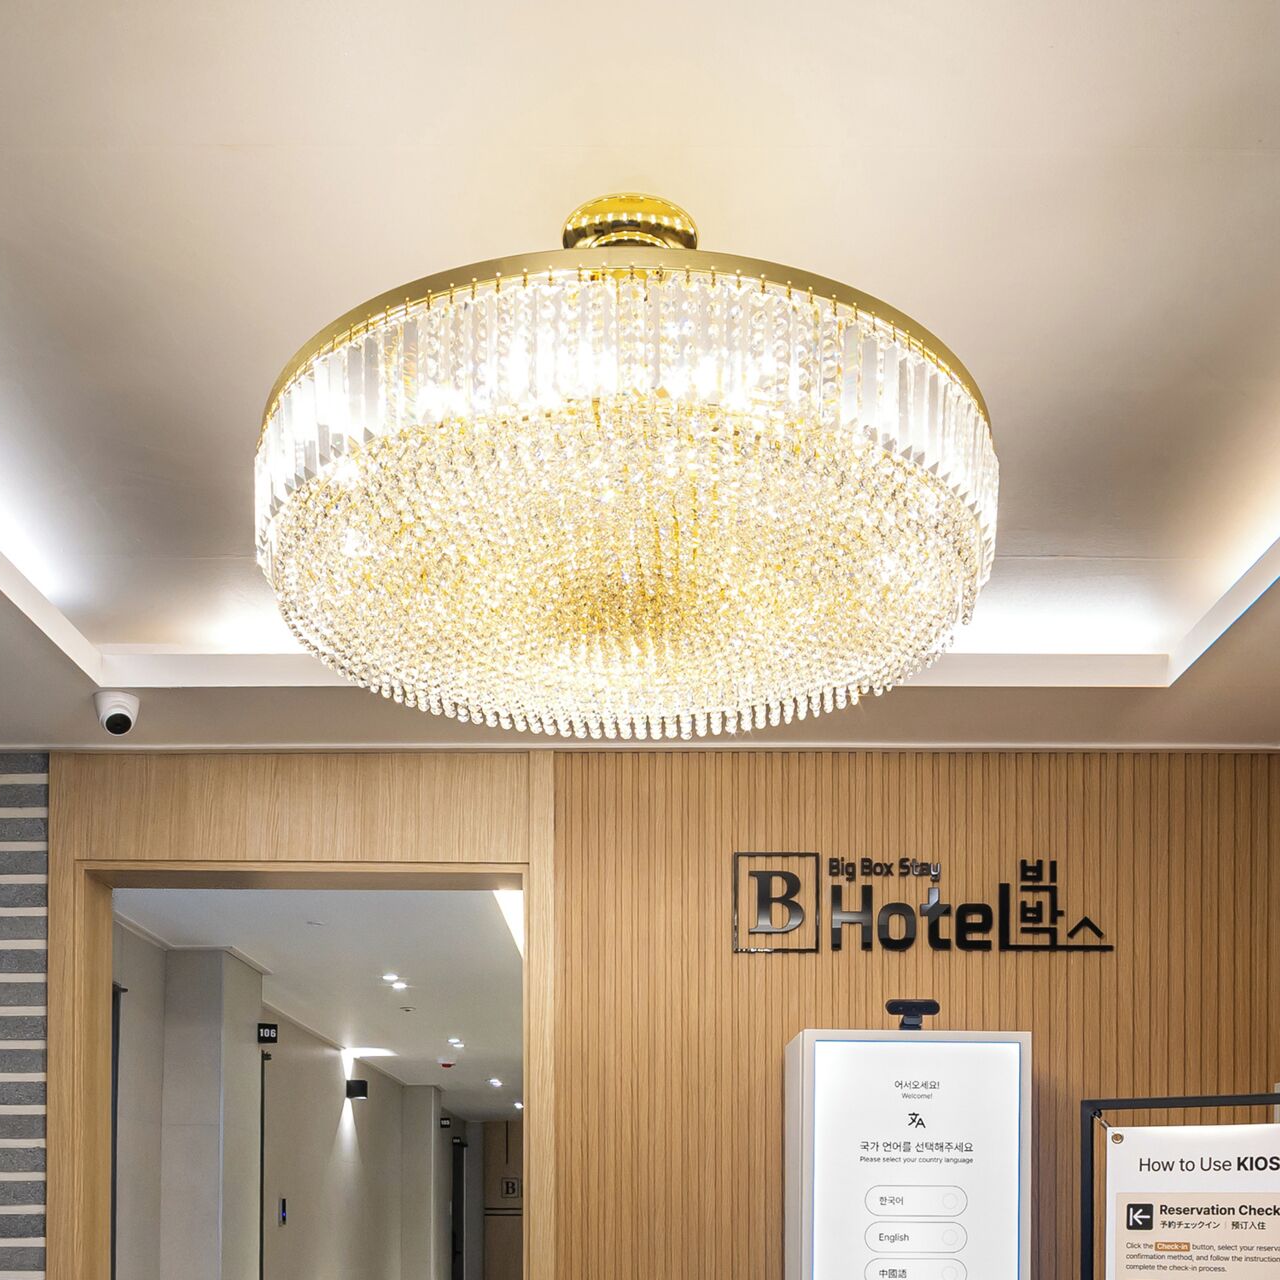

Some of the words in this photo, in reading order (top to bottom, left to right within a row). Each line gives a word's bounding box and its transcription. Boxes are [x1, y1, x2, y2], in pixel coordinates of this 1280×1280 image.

[829, 857, 856, 881] Big
[861, 857, 894, 876] Box
[899, 857, 941, 882] Stay
[748, 870, 805, 934] B
[831, 883, 1010, 951] Hotel
[260, 1029, 276, 1037] 106
[894, 1080, 940, 1089] 어서오세요!
[860, 1142, 879, 1152] 국가
[882, 1142, 911, 1152] 언어를
[915, 1142, 973, 1152] 선택해주세요
[1139, 1158, 1174, 1172] How
[1179, 1158, 1195, 1171] to
[1200, 1157, 1232, 1171] Use
[879, 1197, 903, 1205] 한국어
[1159, 1204, 1235, 1216] Reservation
[1160, 1221, 1220, 1229] 予約チェックイン
[878, 1233, 909, 1243] English
[1126, 1242, 1141, 1250] Click
[1143, 1242, 1154, 1250] the
[1192, 1244, 1215, 1252] button,
[1126, 1263, 1155, 1271] complete
[1169, 1264, 1197, 1272] check-in
